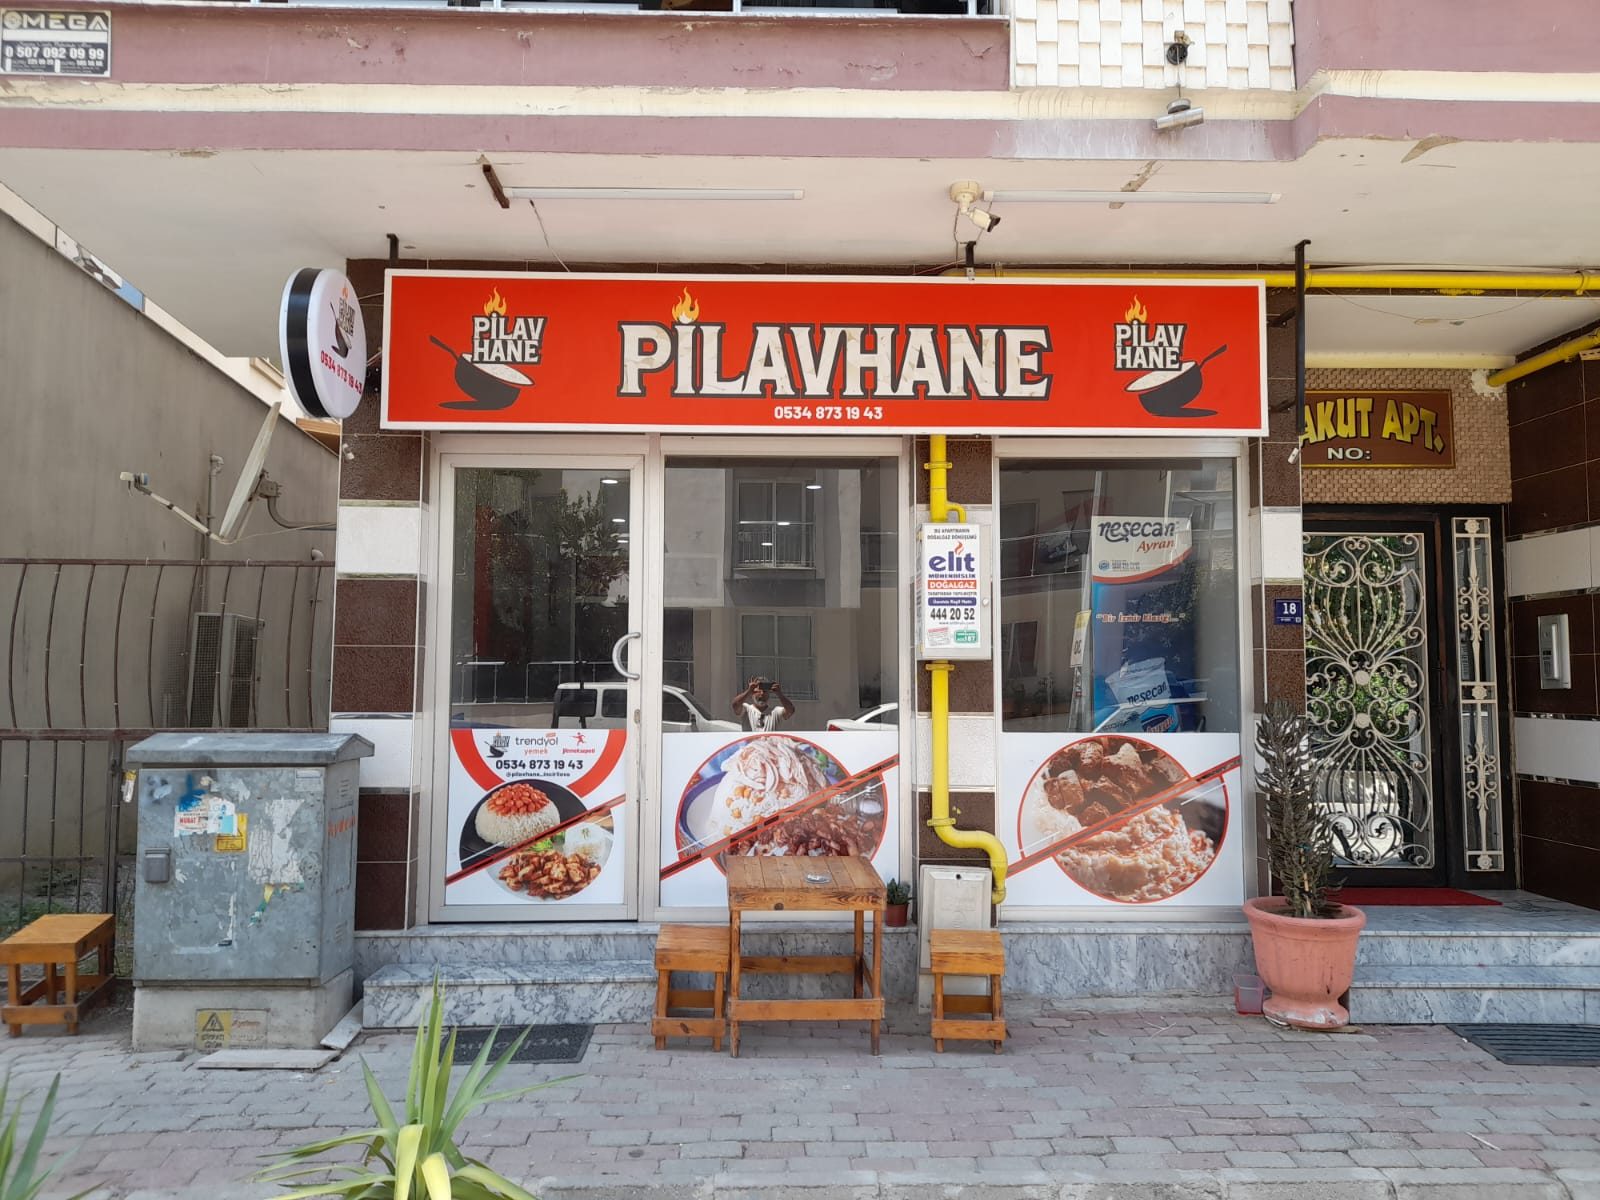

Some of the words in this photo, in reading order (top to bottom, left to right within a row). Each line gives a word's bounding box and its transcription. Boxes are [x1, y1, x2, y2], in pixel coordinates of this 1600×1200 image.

[4, 11, 108, 30] OMEGA
[5, 46, 14, 57] 0
[17, 46, 40, 58] 507
[43, 47, 67, 59] 092
[69, 48, 86, 60] 09
[88, 48, 105, 60] 99
[473, 312, 545, 340] PİLAV
[1115, 319, 1185, 347] PİLAV
[473, 339, 539, 362] HANE
[618, 314, 1052, 399] PİLAVHANE
[1115, 346, 1180, 369] HANE
[774, 406, 812, 421] 0534
[815, 406, 843, 421] 873
[845, 406, 860, 421] 19
[863, 406, 883, 421] 43
[1382, 399, 1445, 453] APT.
[1327, 447, 1372, 460] NO:
[1137, 539, 1175, 553] Ayran
[929, 547, 975, 572] elit
[930, 580, 975, 589] DOĞALGAZ
[930, 607, 947, 620] 444
[950, 607, 961, 620] 20
[964, 607, 975, 620] 52
[1283, 602, 1297, 615] 18
[515, 736, 559, 748] trendyol
[524, 748, 549, 757] yemek
[495, 759, 526, 770] 0534
[529, 759, 551, 770] 873
[554, 759, 565, 770] 19
[568, 759, 584, 770] 43
